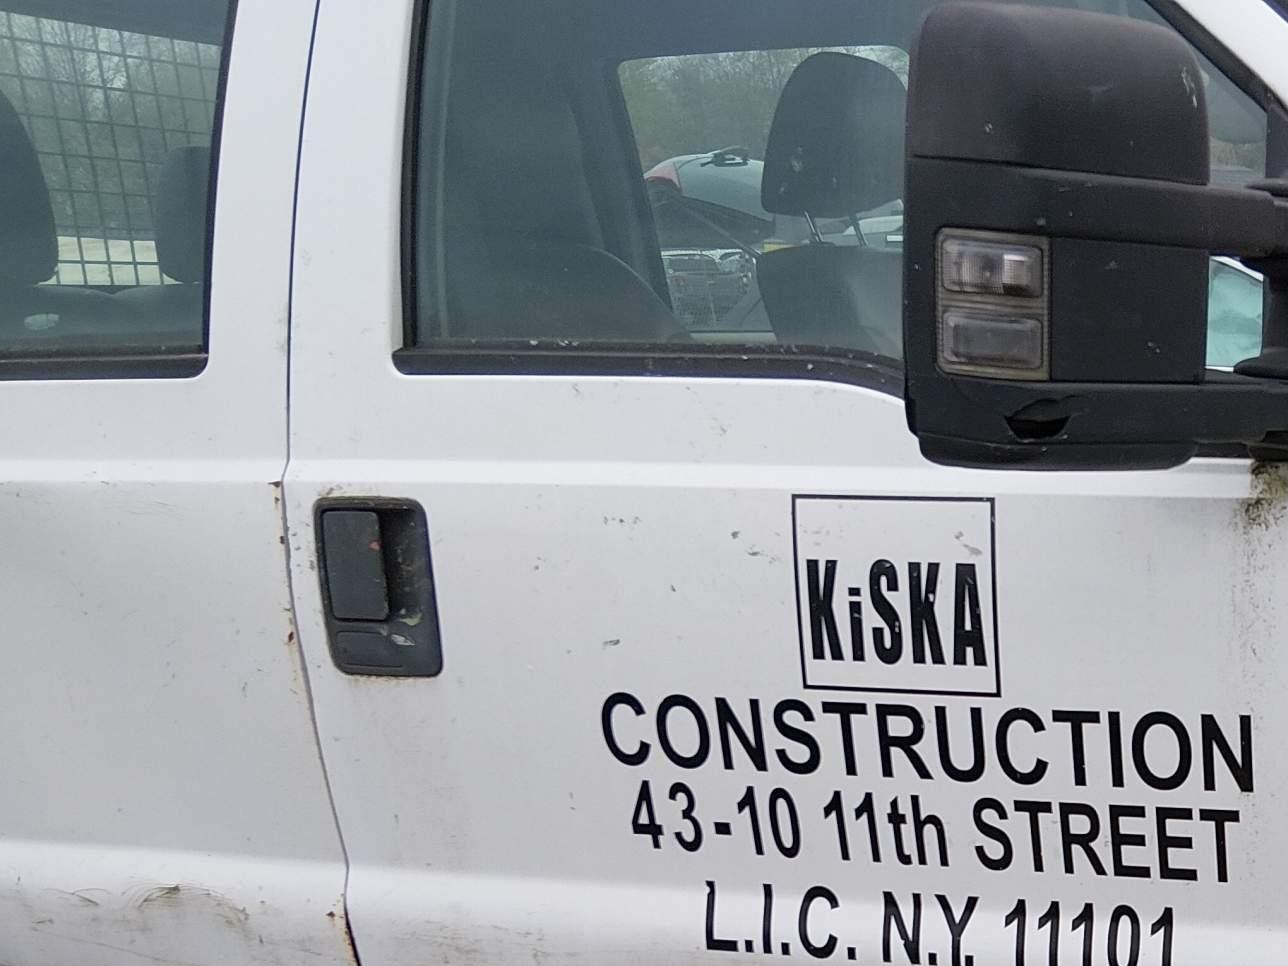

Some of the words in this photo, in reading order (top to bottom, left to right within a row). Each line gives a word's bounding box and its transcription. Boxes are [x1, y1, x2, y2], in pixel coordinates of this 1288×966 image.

[806, 558, 988, 667] KiSKA
[601, 691, 1254, 793] CONSTRUCTION
[631, 779, 801, 859] 43-10
[823, 790, 950, 868] 11th
[972, 797, 1241, 883] STREET
[705, 880, 857, 961] L.I.C.
